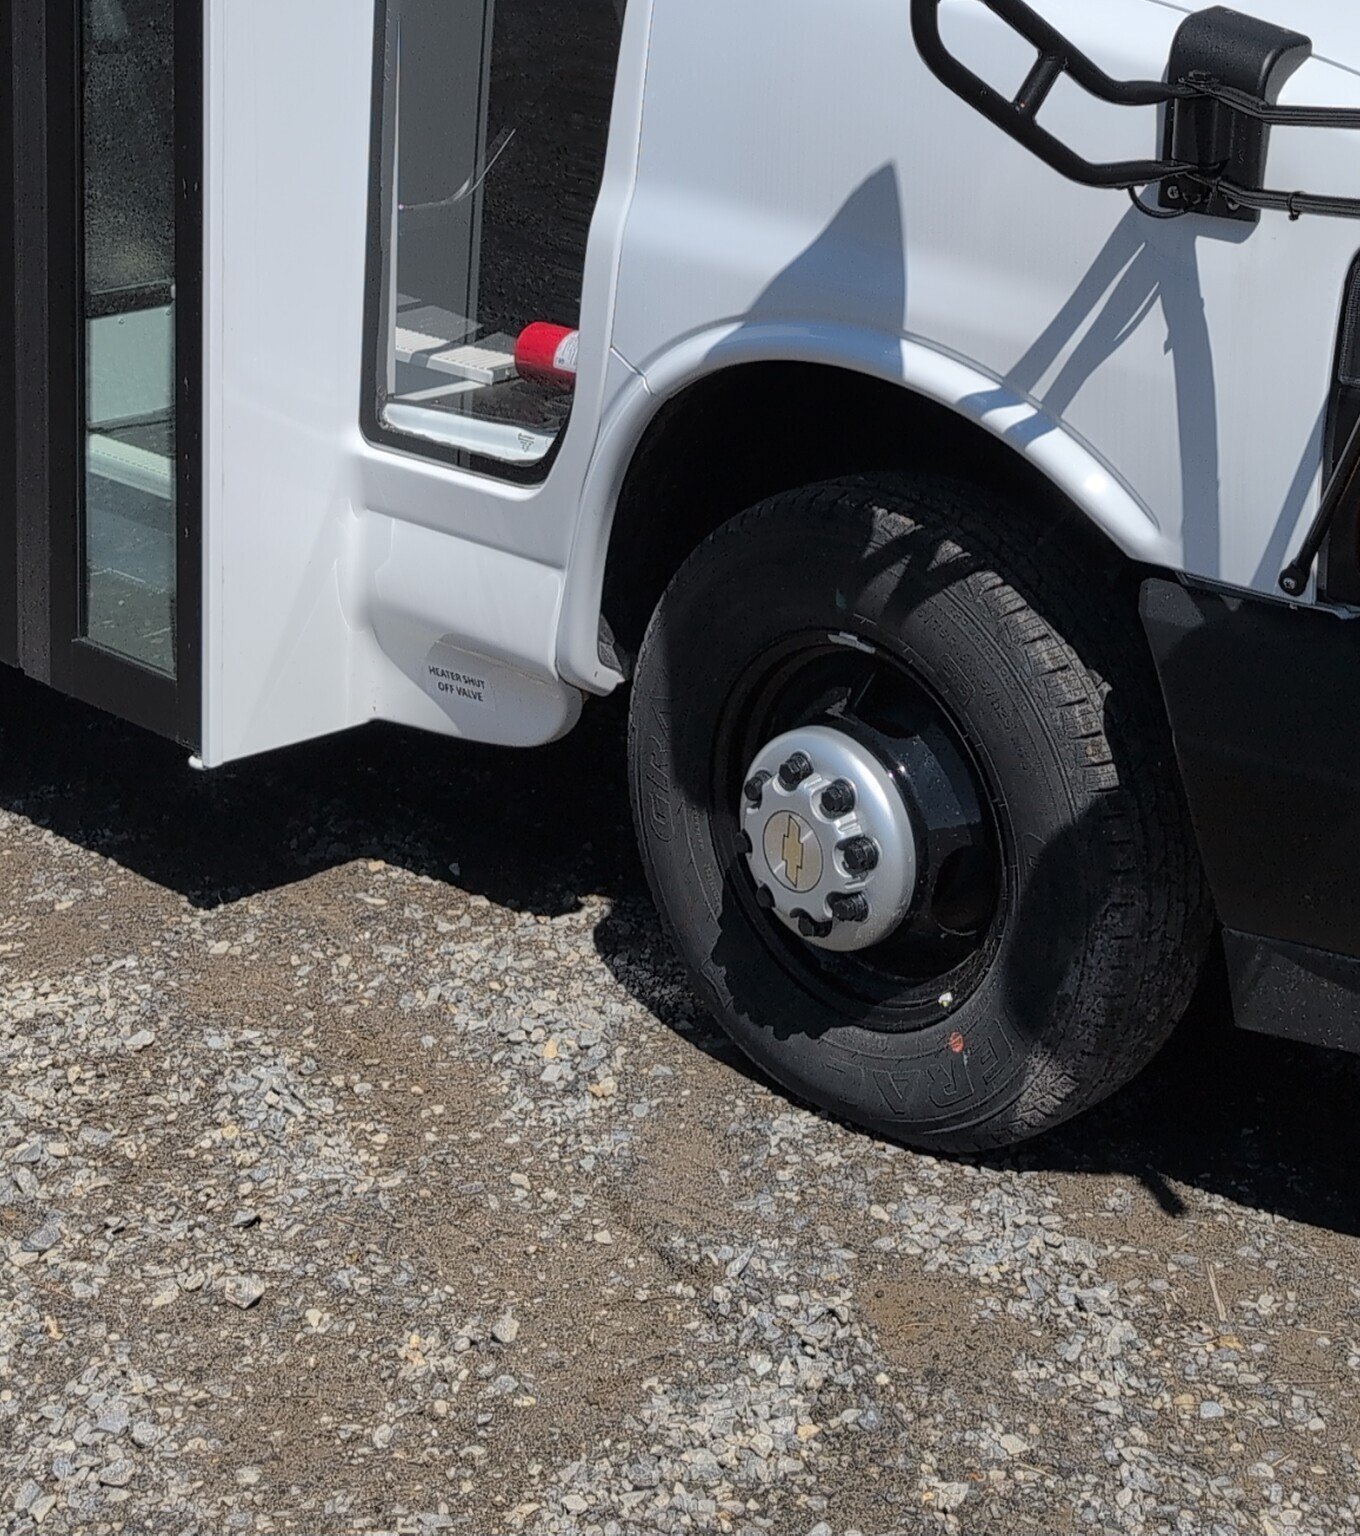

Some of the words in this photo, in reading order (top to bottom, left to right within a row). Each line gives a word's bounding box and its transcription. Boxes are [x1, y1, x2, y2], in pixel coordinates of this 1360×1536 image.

[428, 665, 461, 682] HEATER
[460, 675, 485, 689] SHUT
[437, 681, 455, 694] OFF
[455, 686, 484, 702] VALVE
